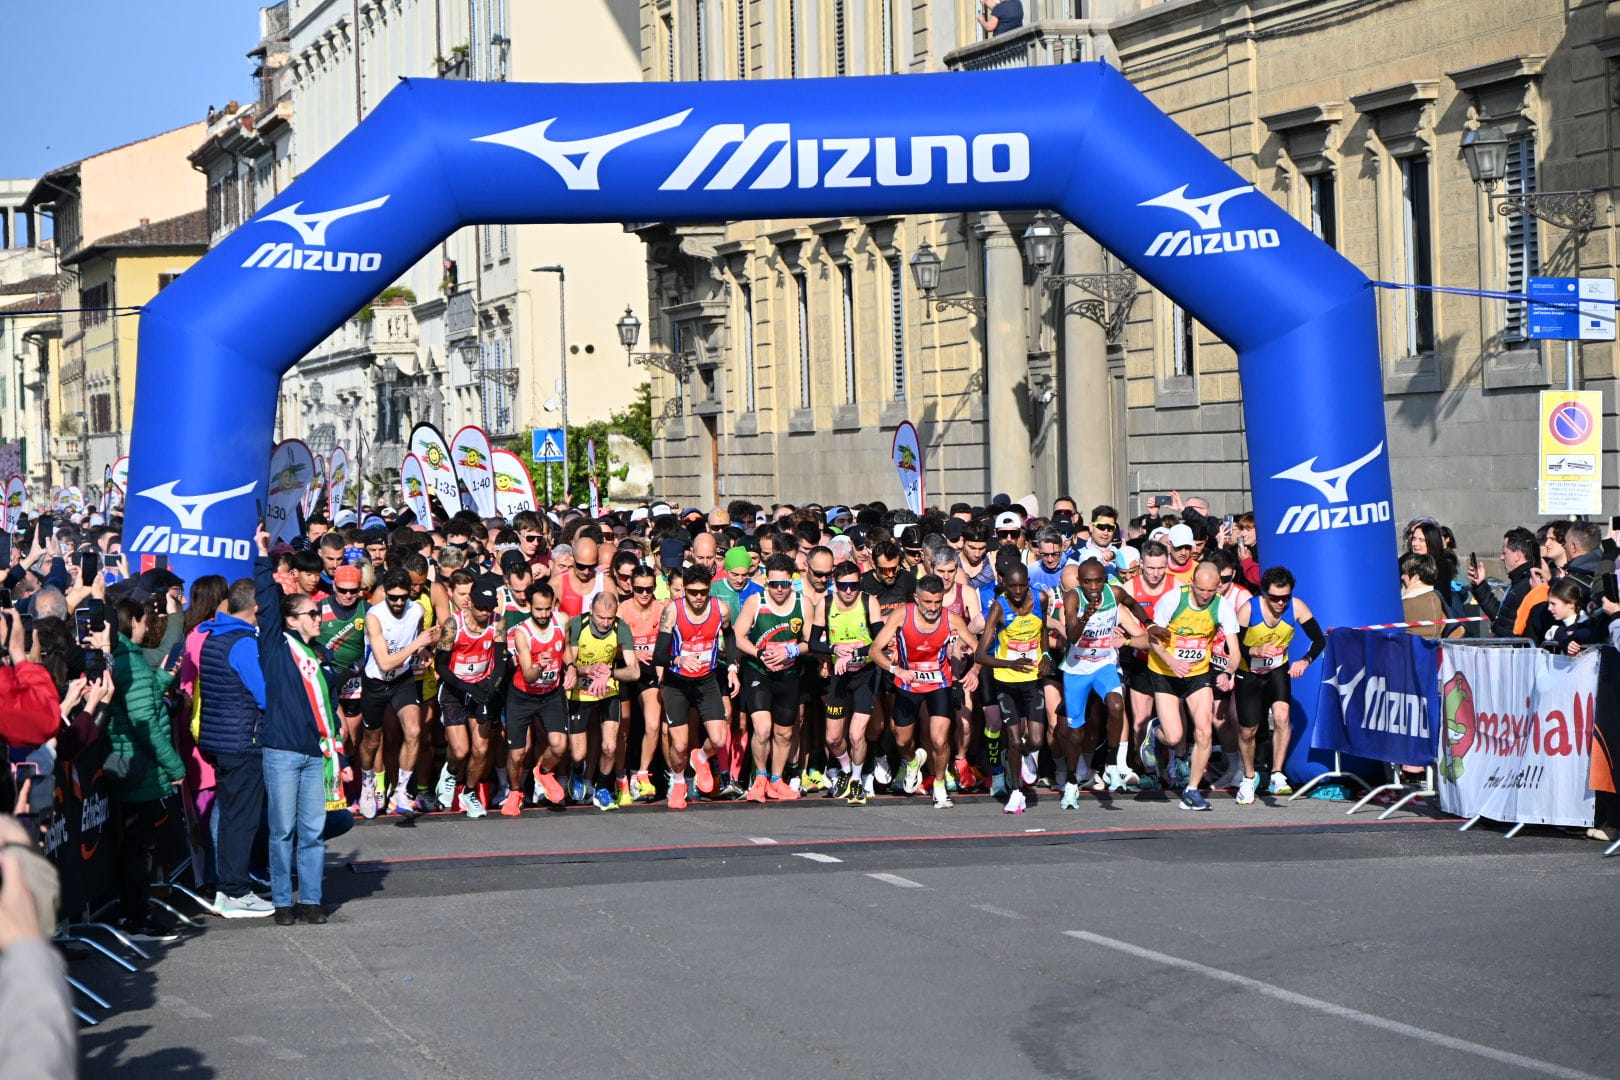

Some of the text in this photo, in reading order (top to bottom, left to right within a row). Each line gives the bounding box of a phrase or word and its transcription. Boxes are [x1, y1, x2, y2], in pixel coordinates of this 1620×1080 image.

[658, 122, 1030, 190] MIZUNO
[1144, 229, 1281, 257] MIZUNO
[240, 242, 382, 272] MIZUNO
[434, 478, 457, 498] 1:35
[472, 477, 490, 491] 1:40
[266, 504, 286, 521] 1:30
[507, 501, 530, 515] 1:40
[1275, 500, 1390, 534] MIZUNO
[129, 525, 251, 560] MIZUNO
[1177, 649, 1203, 659] 2226
[1262, 657, 1274, 667] 10
[467, 664, 474, 672] 4
[914, 671, 936, 680] 1411
[1475, 691, 1594, 757] maxiall
